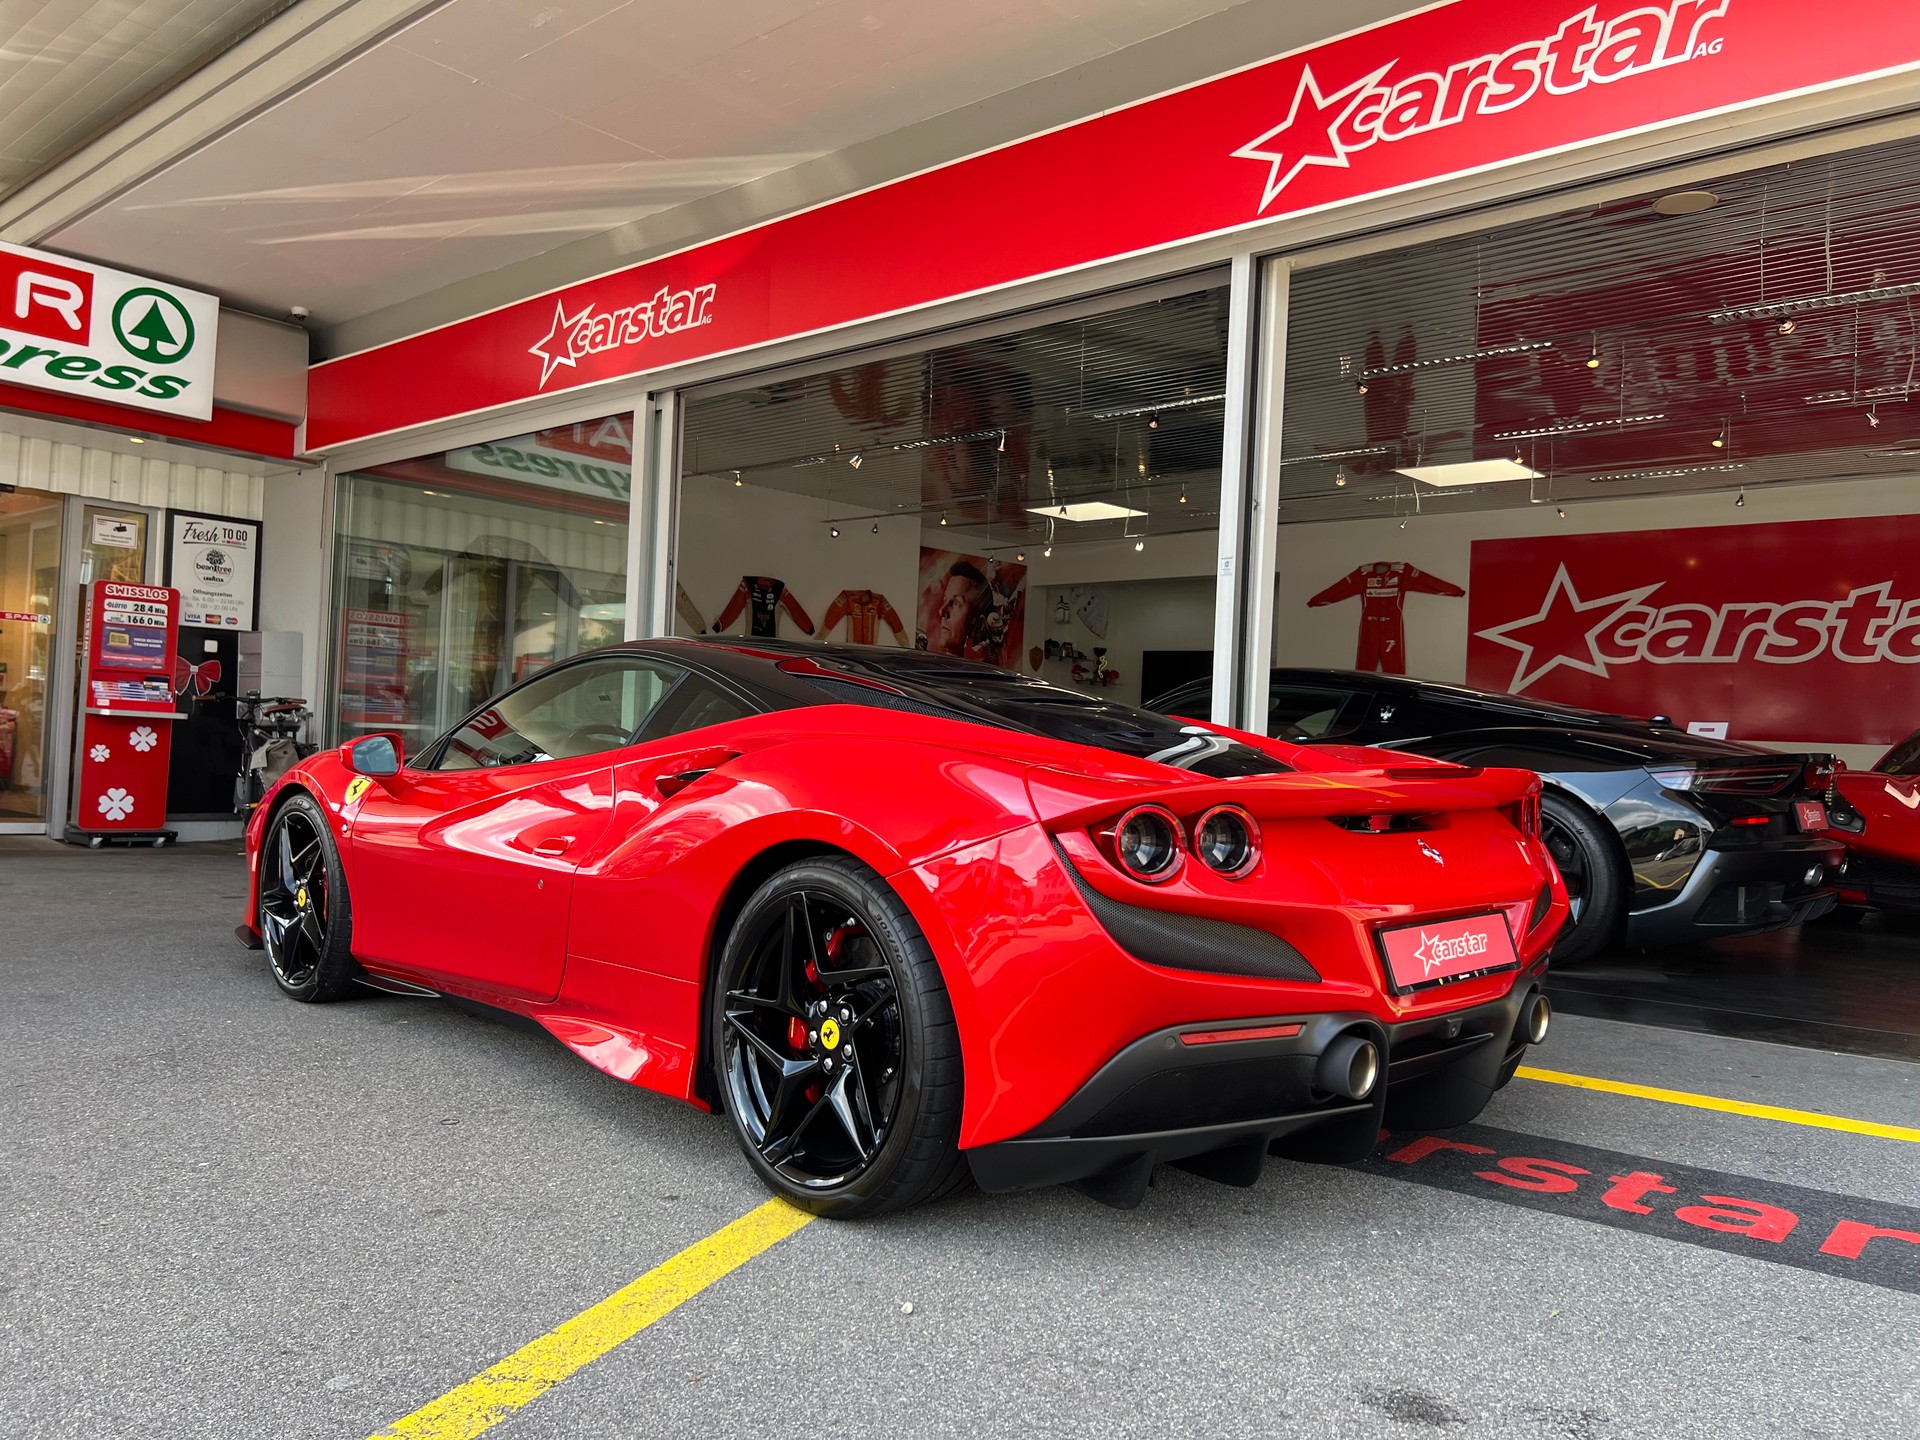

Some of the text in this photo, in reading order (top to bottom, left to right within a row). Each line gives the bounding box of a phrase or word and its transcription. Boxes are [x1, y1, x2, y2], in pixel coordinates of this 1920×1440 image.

[1331, 0, 1729, 153] carstar AG
[15, 271, 84, 331] R
[569, 283, 717, 358] carstar AG
[183, 522, 219, 543] Fresh
[222, 528, 233, 539] TO
[236, 530, 248, 541] GO
[106, 584, 169, 600] SWISSLOS
[193, 588, 233, 598] Öffnungszeiten
[5, 612, 38, 622] SPAR
[1385, 639, 1396, 653] 7
[873, 913, 904, 964] 305/30
[1431, 930, 1488, 961] carstar
[1378, 1128, 1920, 1259] rstar
